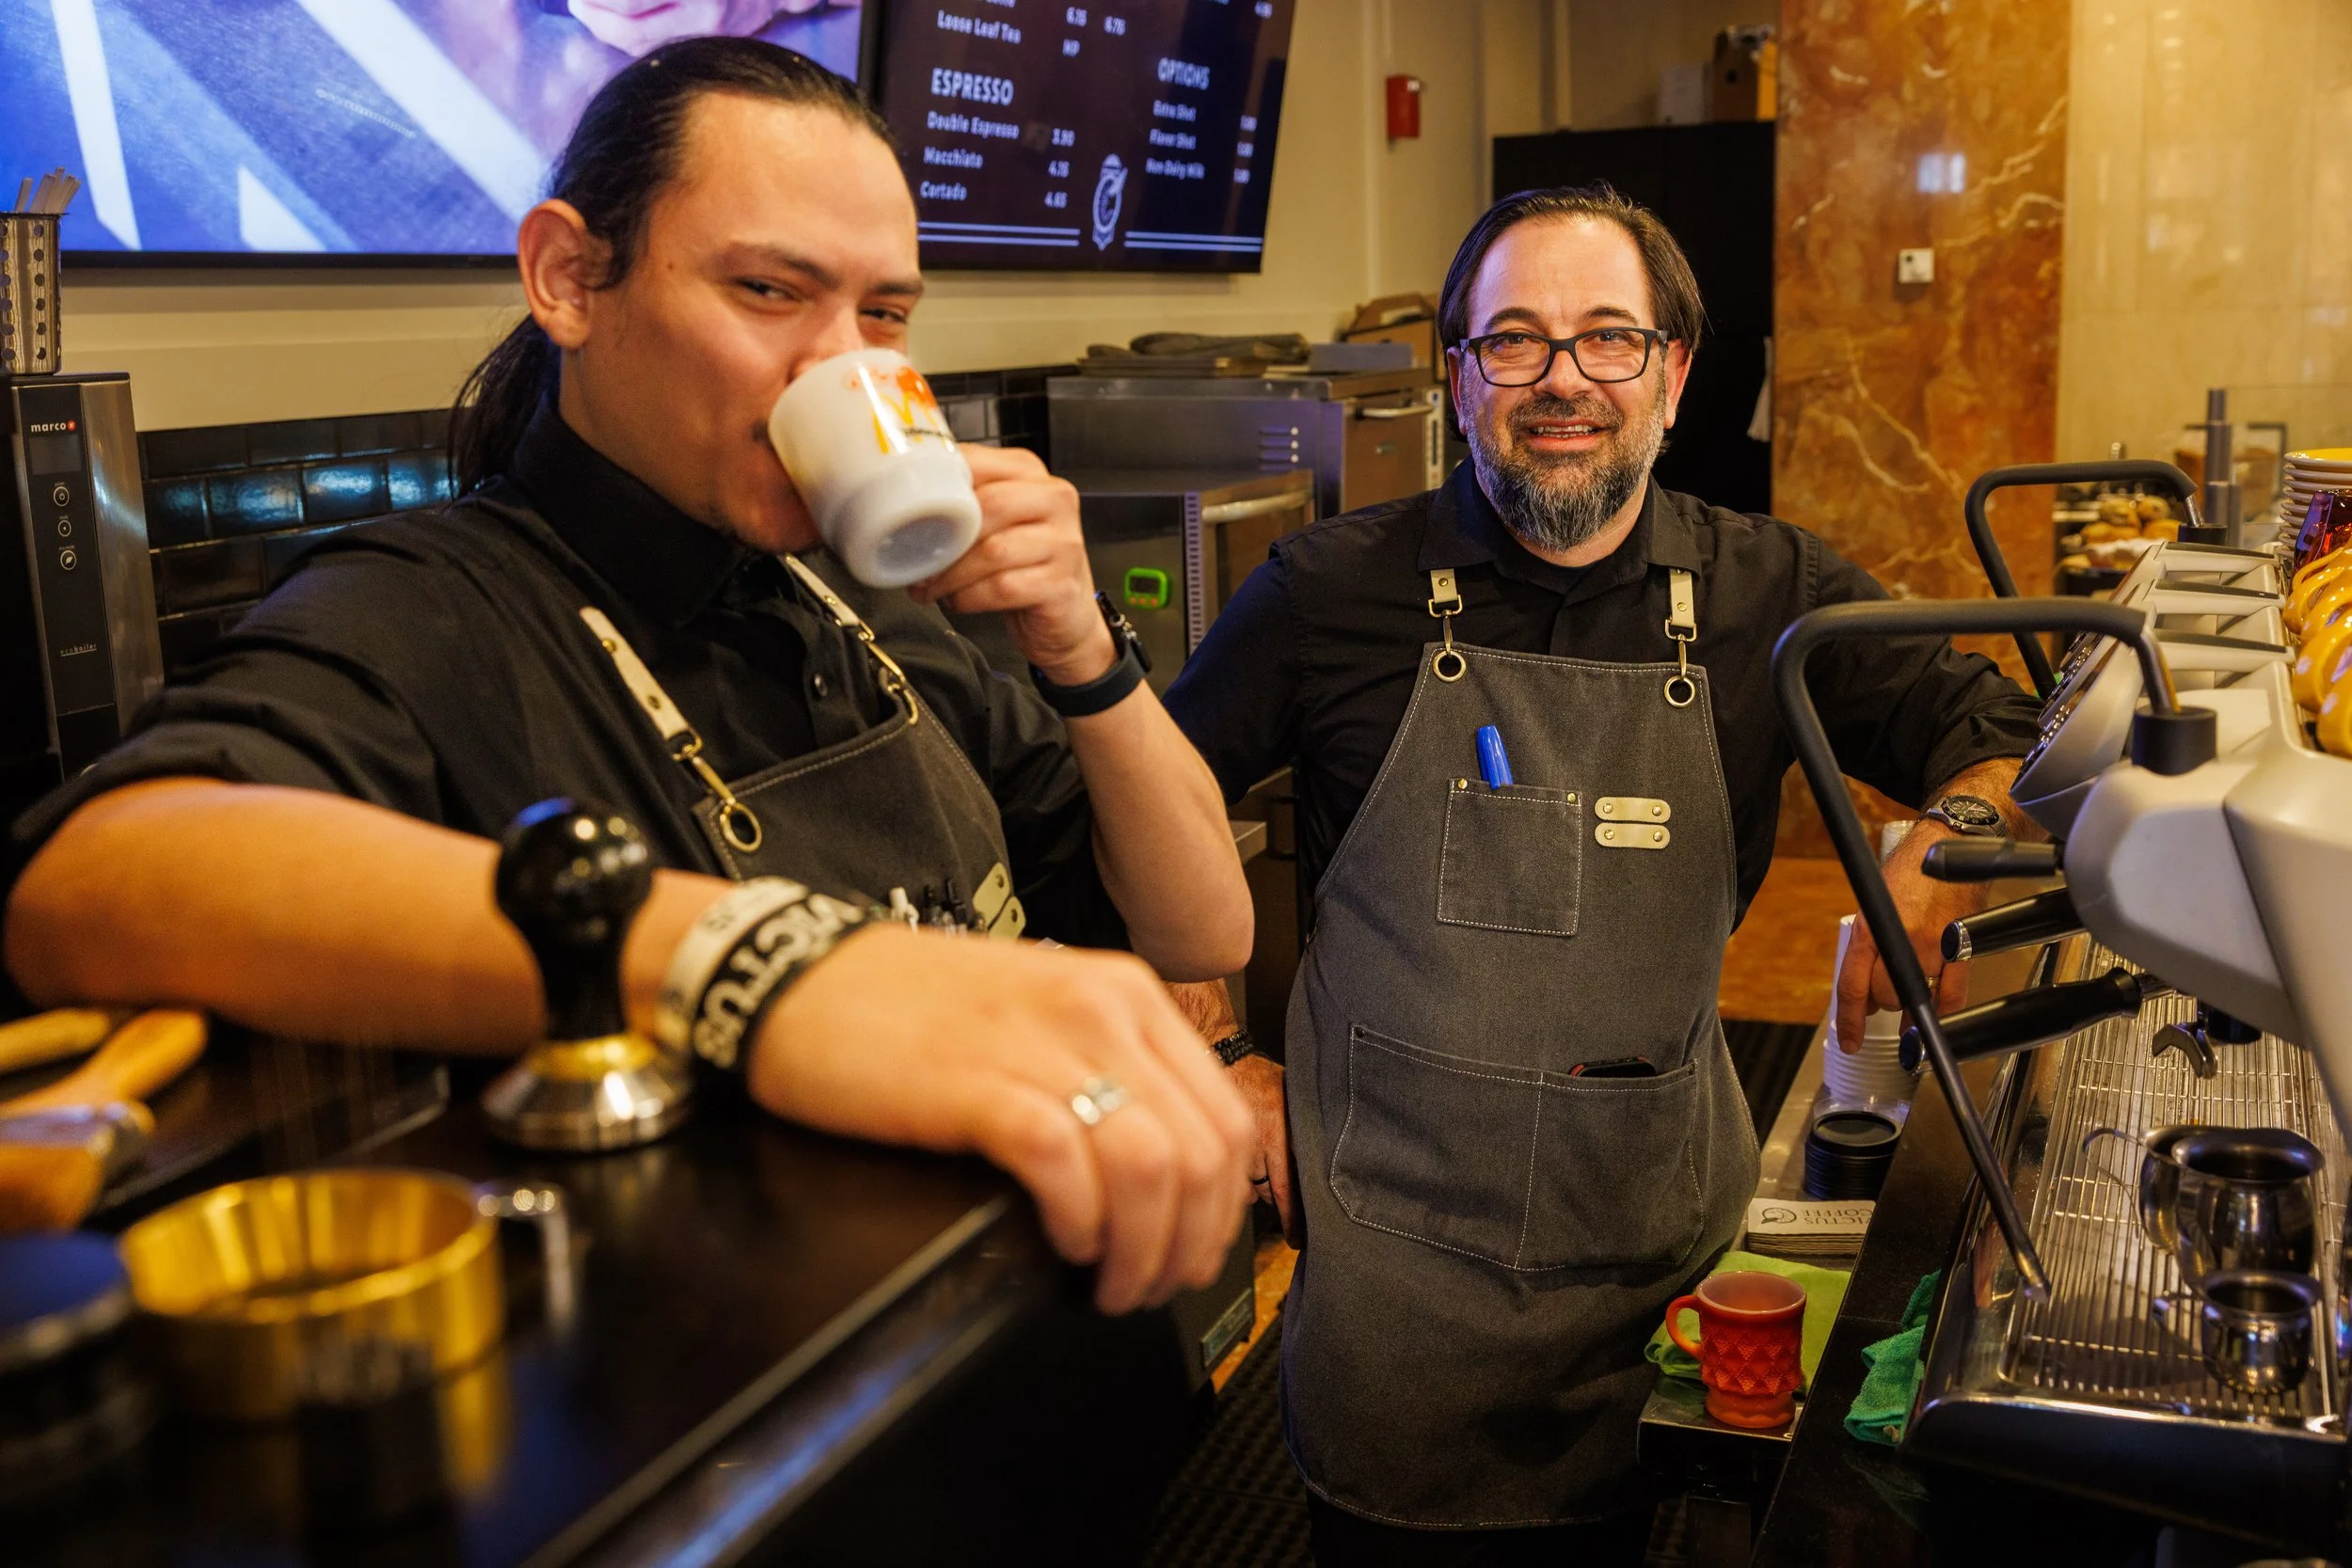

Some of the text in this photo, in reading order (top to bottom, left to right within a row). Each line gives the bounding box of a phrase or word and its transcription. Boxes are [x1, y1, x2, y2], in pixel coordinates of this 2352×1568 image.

[937, 9, 1021, 44] Loose Leaf Tea
[1158, 57, 1210, 90] OPTIONS
[931, 67, 1014, 105] ESPRESSO
[927, 110, 1075, 147] Double Espresso 3.90
[923, 146, 983, 168] Macchiato
[920, 181, 967, 200] Cortado
[31, 422, 67, 433] marco
[60, 643, 97, 655] ecoboiler
[1803, 1208, 1872, 1217] COFFEE
